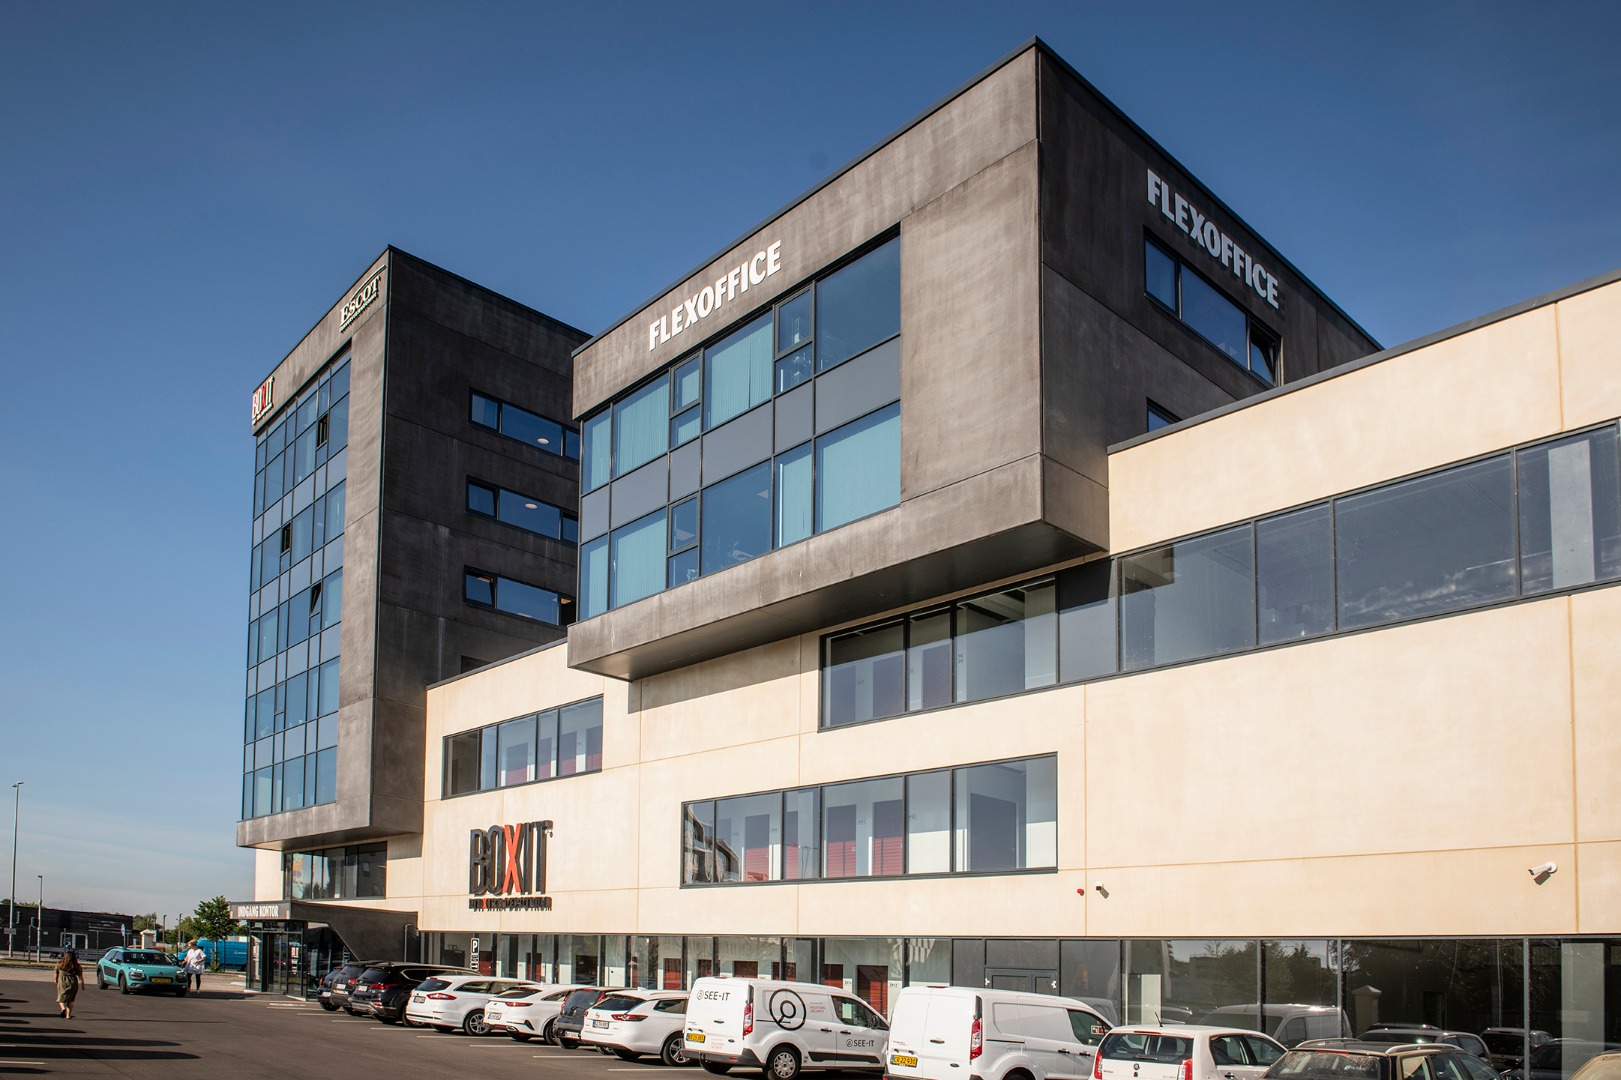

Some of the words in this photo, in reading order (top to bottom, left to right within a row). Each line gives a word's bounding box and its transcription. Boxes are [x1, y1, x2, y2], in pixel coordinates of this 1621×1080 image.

[1147, 168, 1279, 310] FLEXOFFICE
[649, 239, 782, 352] FLEXOFFICE
[469, 820, 553, 897] BOXIT
[237, 905, 258, 917] INDGANG
[259, 905, 279, 917] KONTOR
[472, 940, 478, 953] P
[703, 990, 731, 1001] SEE-IT
[853, 1039, 875, 1047] SEE-IT
